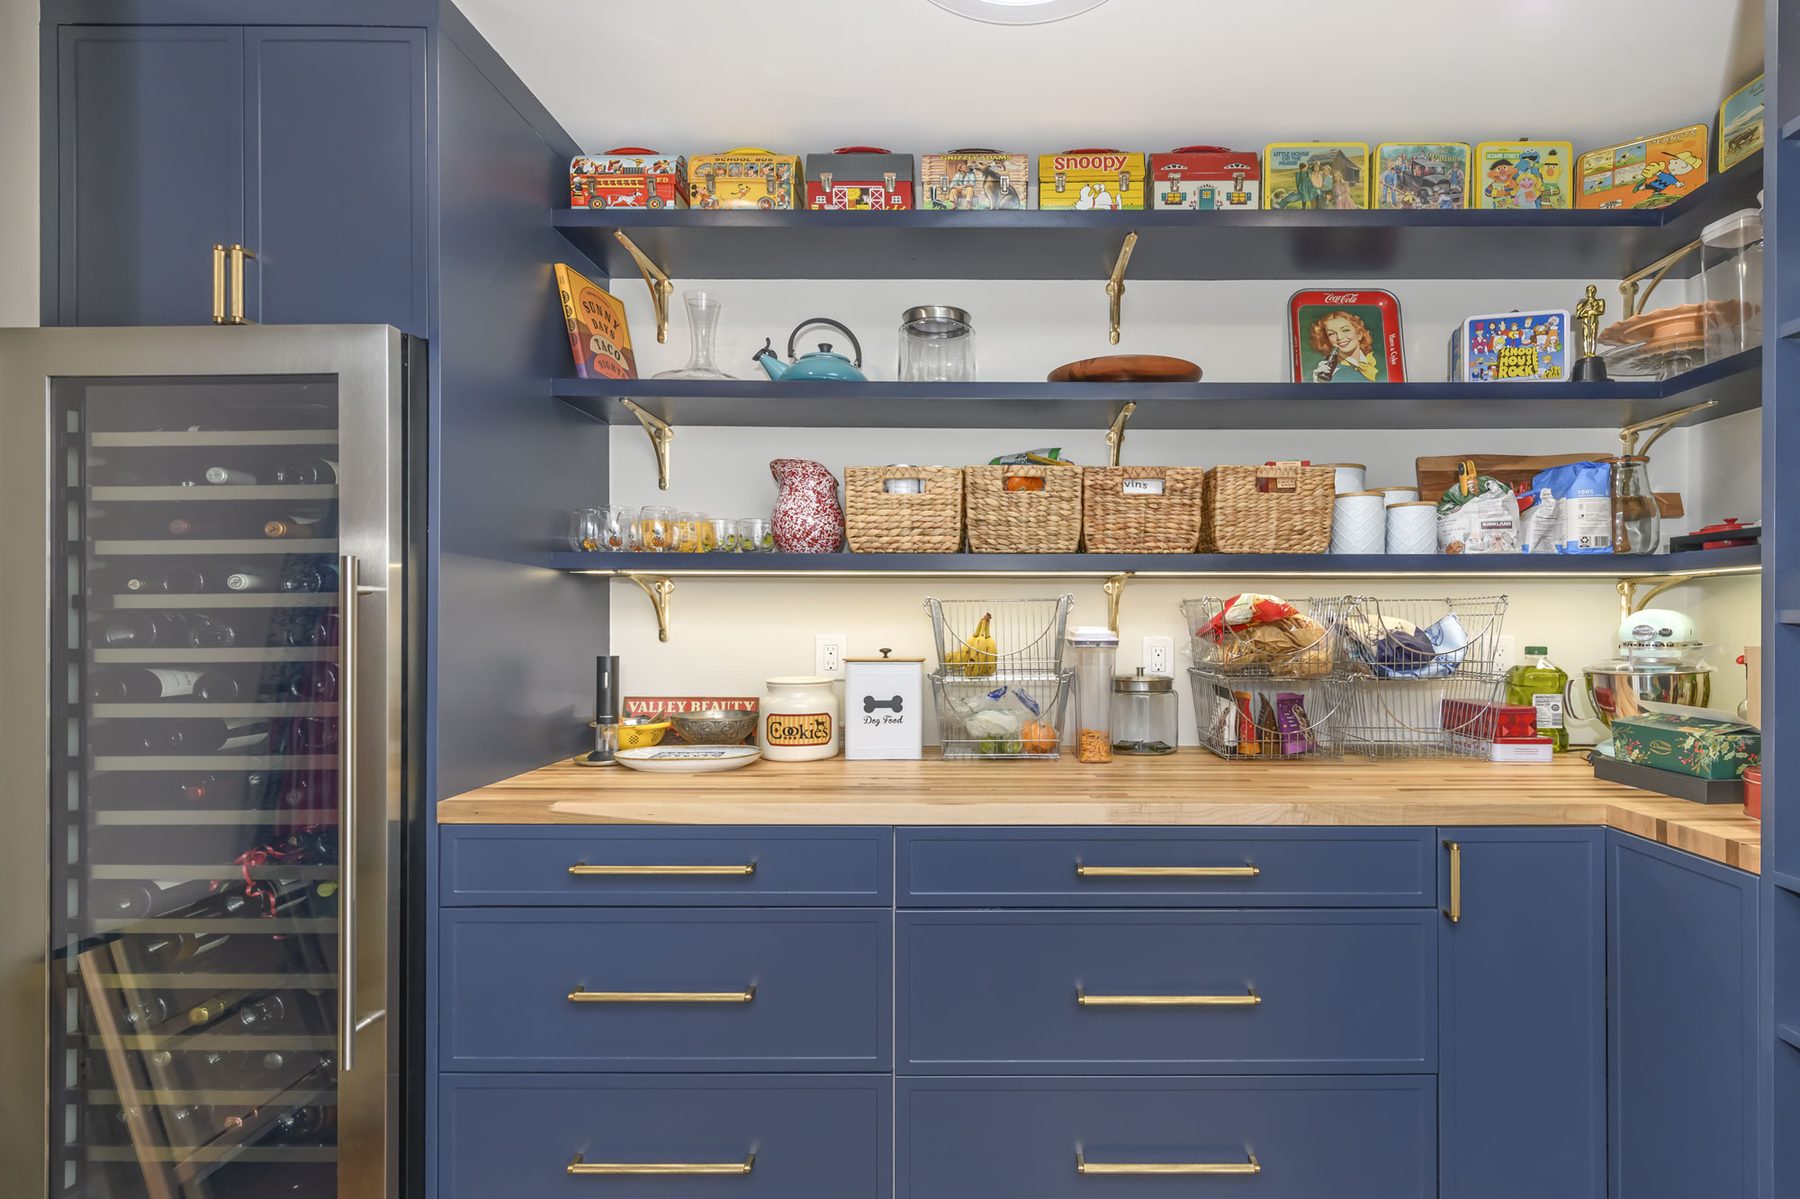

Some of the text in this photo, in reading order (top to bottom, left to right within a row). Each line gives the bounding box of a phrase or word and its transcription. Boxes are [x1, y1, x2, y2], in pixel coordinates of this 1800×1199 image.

[582, 300, 620, 330] SUNNY
[590, 318, 616, 340] DAYS
[593, 338, 621, 361] TACO
[628, 701, 755, 713] VALLEY BEAUTY
[770, 721, 829, 740] Cookies
[863, 715, 904, 727] Dog Food
